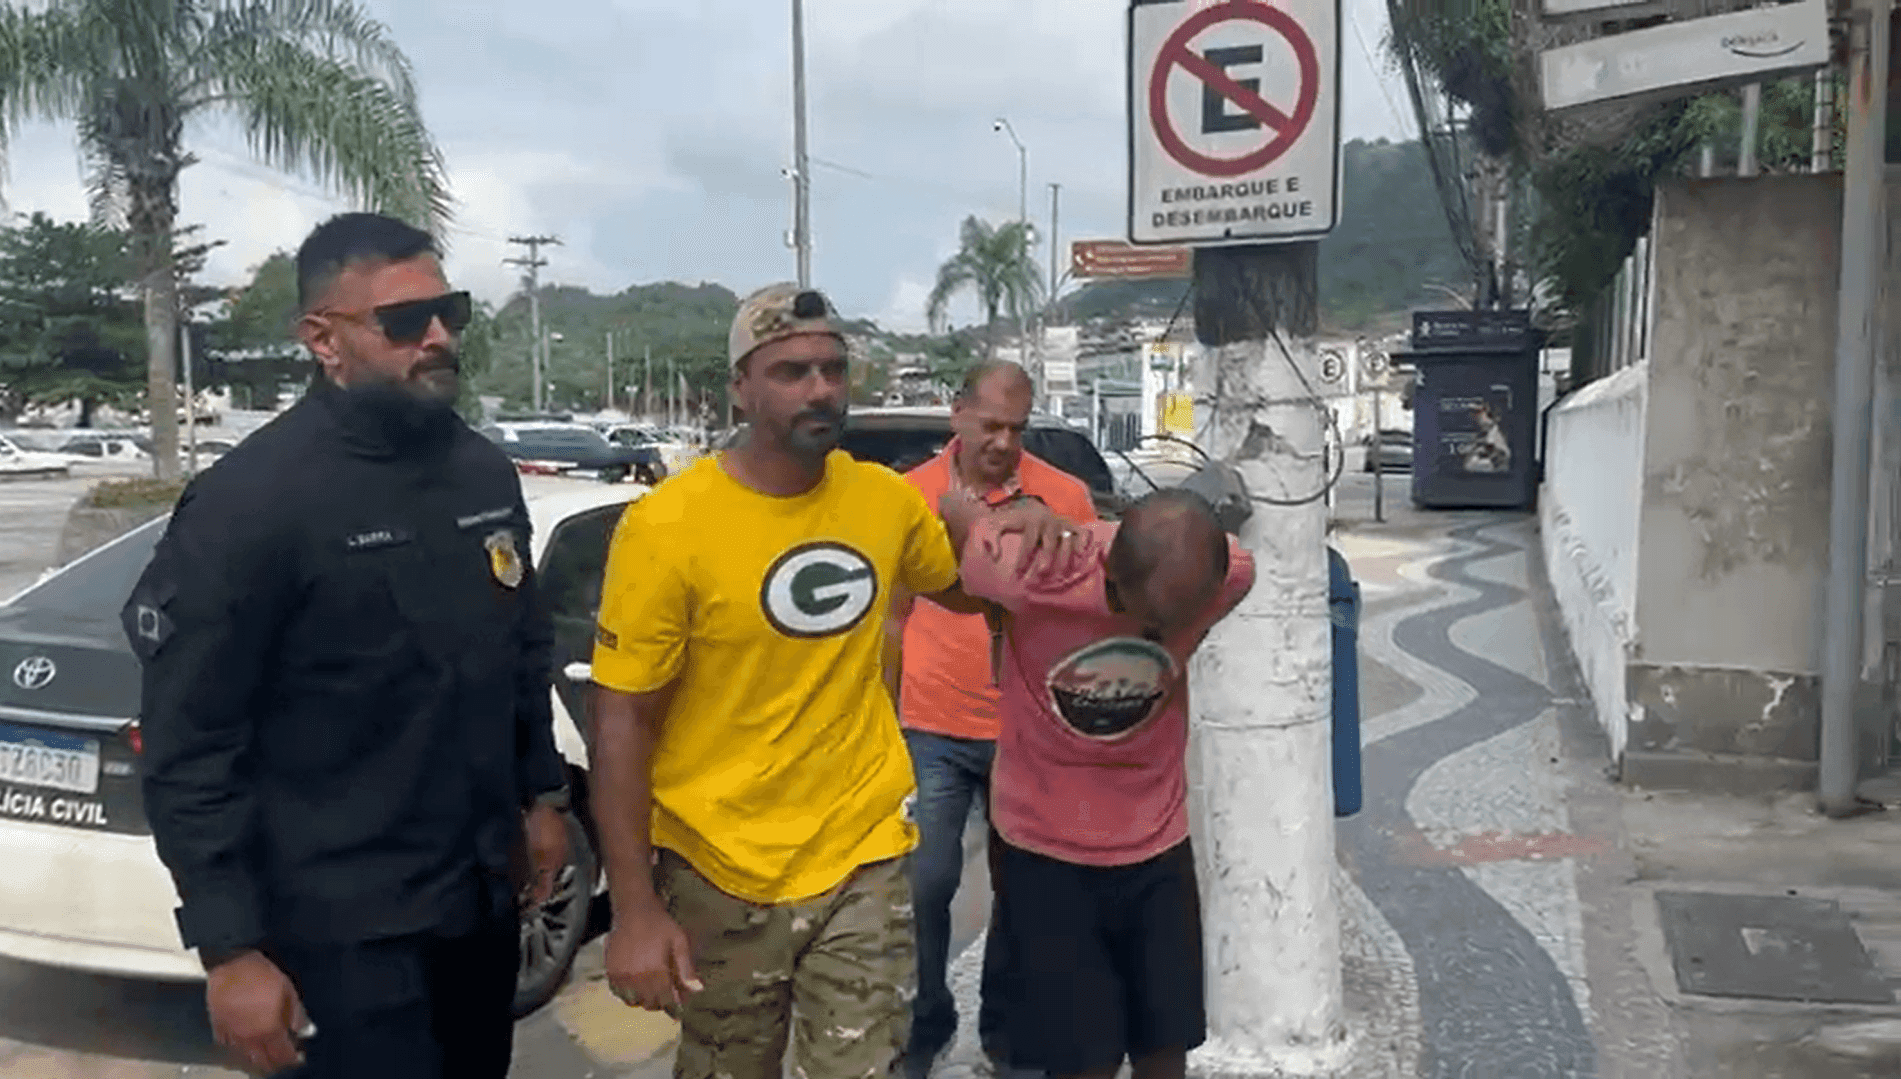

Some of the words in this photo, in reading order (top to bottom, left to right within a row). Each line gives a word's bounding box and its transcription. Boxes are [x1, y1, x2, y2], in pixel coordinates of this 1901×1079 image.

[1202, 44, 1263, 134] E
[1161, 179, 1279, 203] EMBARQUE
[1286, 176, 1299, 192] E
[1152, 201, 1312, 228] DESEMBARQUE
[764, 546, 876, 636] G
[51, 798, 107, 824] CIVIL
